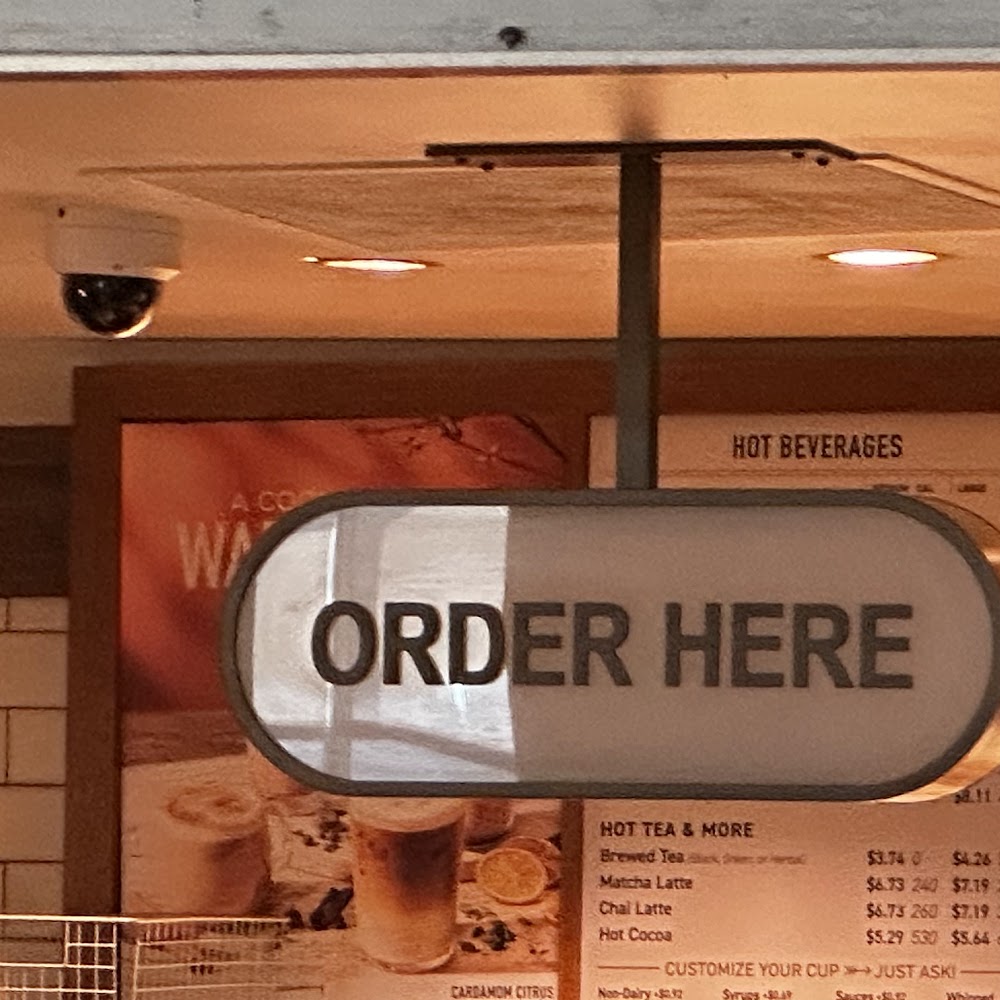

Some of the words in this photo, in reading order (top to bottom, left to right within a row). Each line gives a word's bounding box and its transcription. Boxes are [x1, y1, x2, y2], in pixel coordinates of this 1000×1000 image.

[733, 434, 770, 458] HOT
[780, 434, 904, 458] BEVERAGES
[311, 601, 633, 687] ORDER
[664, 602, 915, 690] HERE
[601, 821, 636, 837] HOT
[642, 822, 676, 837] TEA
[682, 823, 694, 837] &
[702, 822, 754, 838] MORE
[600, 849, 655, 863] Brewed
[659, 848, 685, 863] Tea
[867, 849, 905, 866] $3.74
[952, 849, 991, 866] $4.26
[600, 876, 652, 890] Matcha
[657, 876, 693, 890] Latte
[866, 876, 905, 893] $6.73
[952, 876, 990, 893] $7.19
[599, 901, 631, 915] Chai
[636, 902, 672, 915] Latte
[866, 902, 905, 919] $6.73
[951, 902, 990, 920] $7.19
[599, 927, 624, 941] Hot
[628, 927, 672, 941] Cocoa
[866, 929, 904, 946] $5.29
[664, 961, 755, 977] CUSTOMIZE
[759, 962, 802, 977] YOUR
[806, 963, 840, 978] CUP
[874, 964, 915, 979] JUST
[451, 986, 513, 999] CARDAMOM
[516, 986, 555, 999] CITRUS
